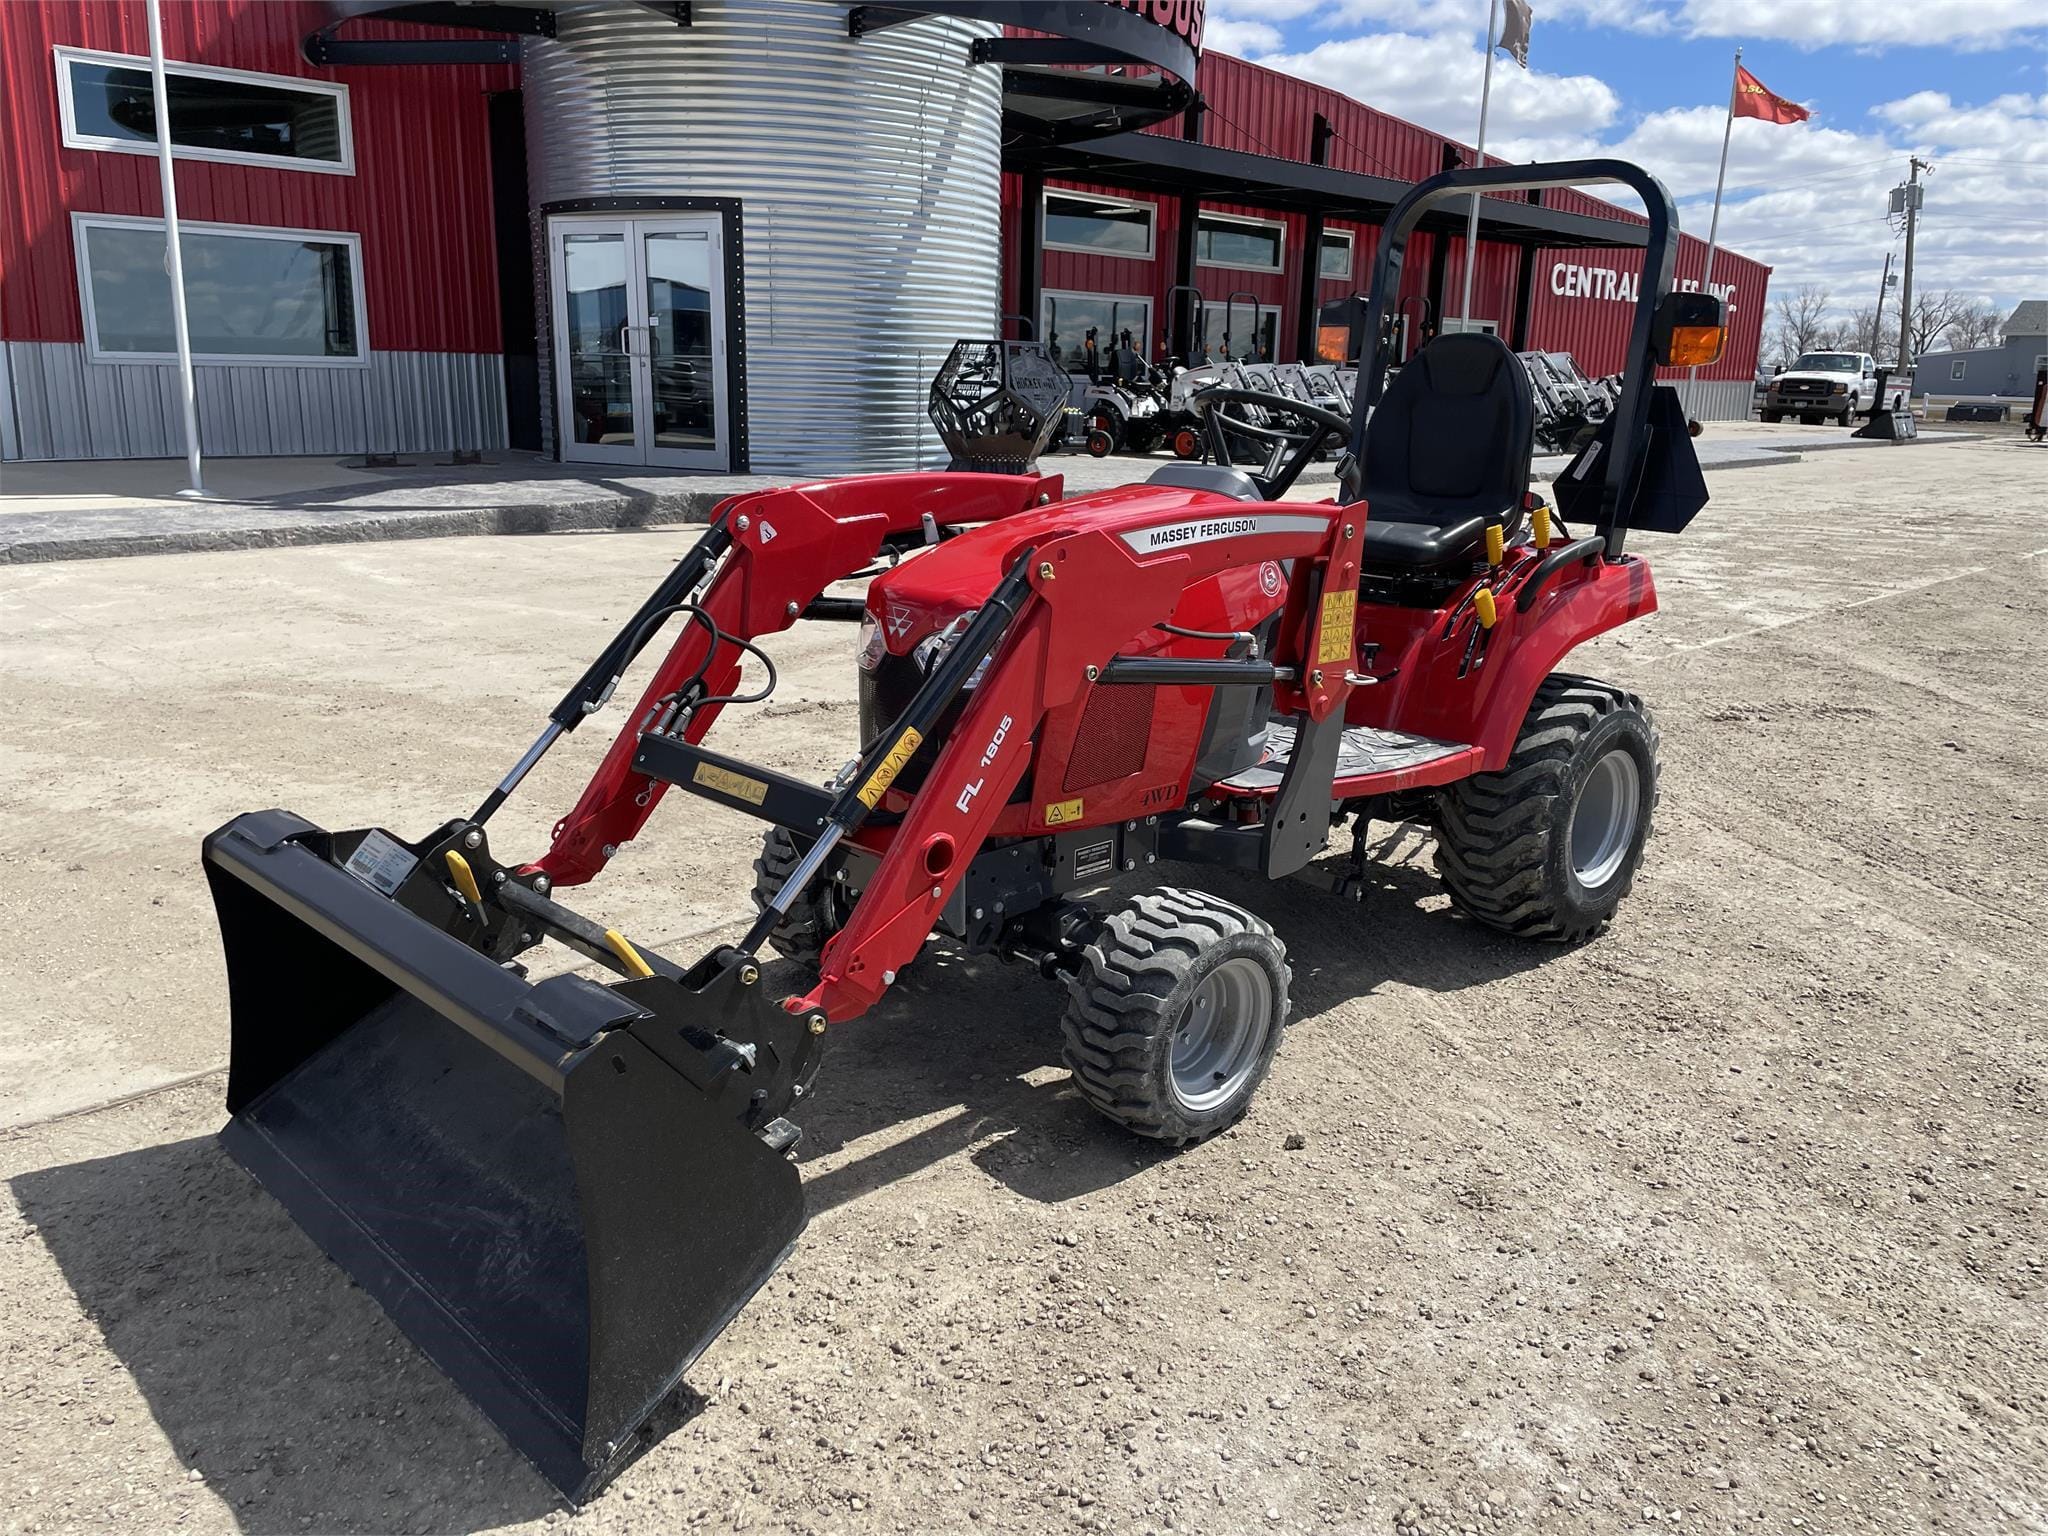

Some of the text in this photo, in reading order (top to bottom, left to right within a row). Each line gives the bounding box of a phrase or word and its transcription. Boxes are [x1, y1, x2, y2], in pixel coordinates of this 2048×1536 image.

[1551, 262, 1639, 303] CENTRAL
[1150, 519, 1257, 546] MASSEY FERGUSON
[955, 714, 1014, 814] FL 1805
[1141, 783, 1180, 807] 4WD
